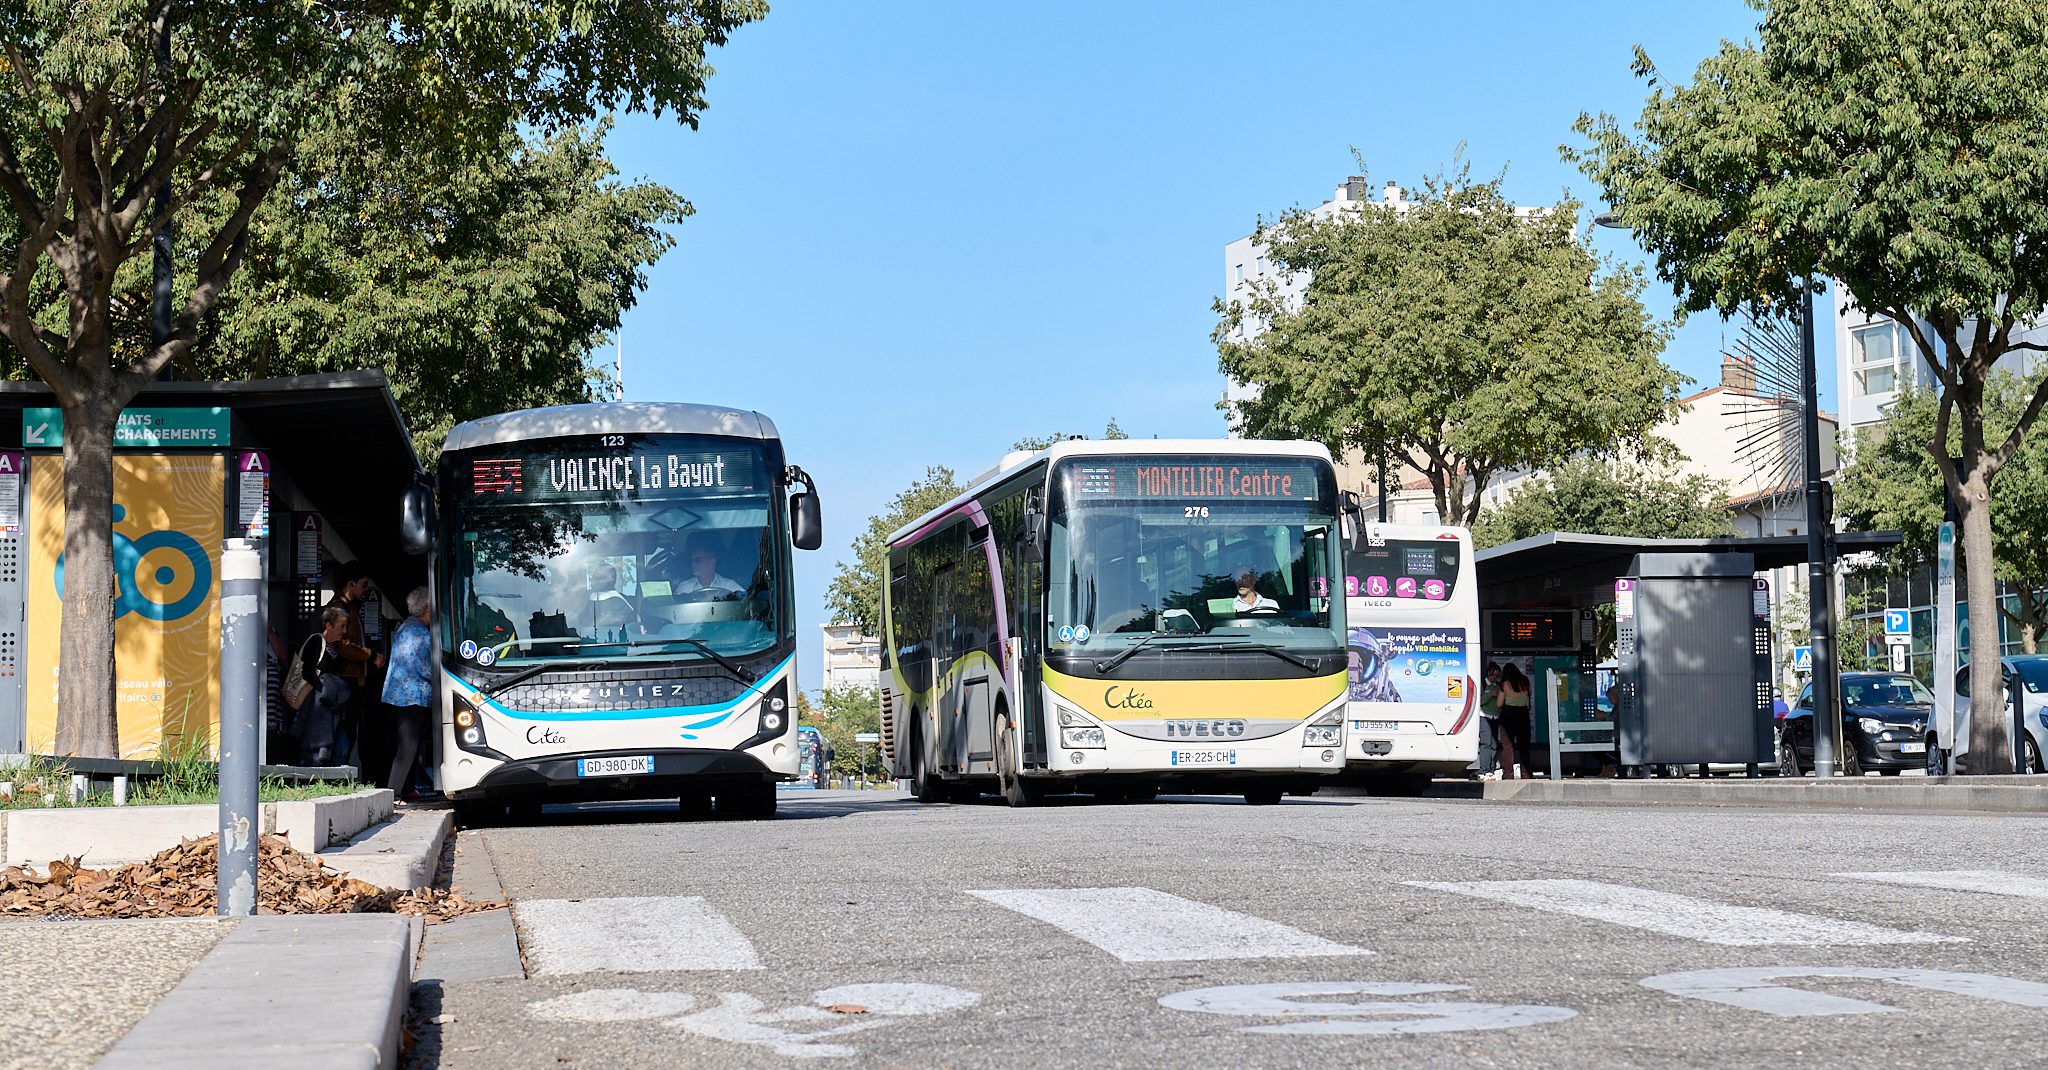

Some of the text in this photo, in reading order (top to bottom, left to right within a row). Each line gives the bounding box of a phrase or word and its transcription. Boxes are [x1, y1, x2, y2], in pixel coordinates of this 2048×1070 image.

[118, 415, 164, 426] HATS et
[115, 428, 217, 440] CHARGEMENTS
[601, 436, 625, 447] 123
[0, 454, 13, 472] A
[246, 452, 263, 471] A
[551, 456, 634, 492] VALENCE
[640, 455, 662, 489] La
[668, 454, 725, 489] Bayot
[1137, 467, 1224, 496] MONTELIER
[1229, 466, 1293, 496] Centre
[1184, 507, 1209, 518] 276
[303, 515, 317, 530] A
[1619, 579, 1629, 590] D
[1756, 579, 1766, 590] D
[368, 590, 378, 600] A
[1584, 610, 1592, 620] D
[1891, 613, 1904, 630] P
[1396, 635, 1421, 645] voyage
[1422, 633, 1447, 645] partout
[1447, 635, 1464, 643] avec
[1429, 645, 1459, 653] mobilités
[117, 677, 173, 689] éseau vélo
[1104, 685, 1154, 709] Citéa
[1166, 720, 1245, 737] IVECO
[526, 725, 566, 745] Citéa
[1179, 751, 1229, 763] ER-225-CH
[587, 758, 646, 773] GD-980-DK
